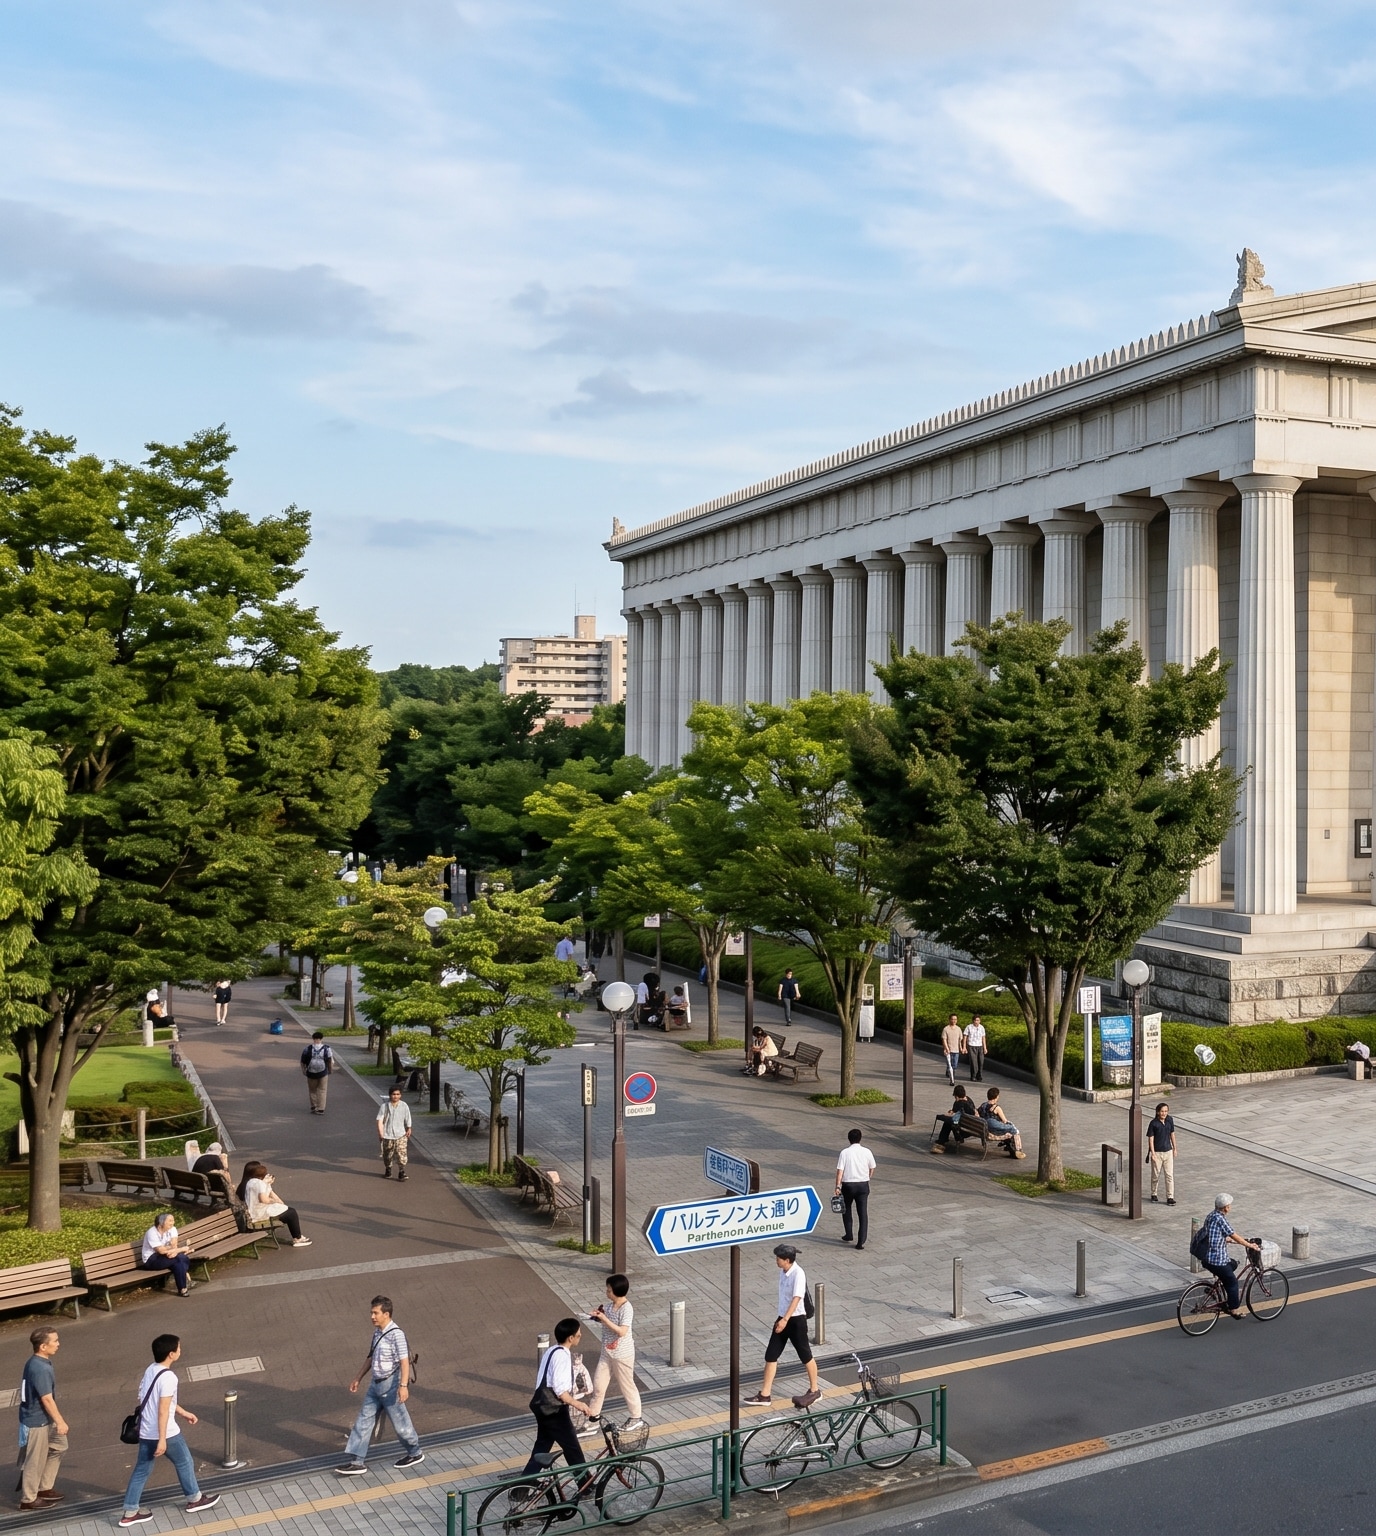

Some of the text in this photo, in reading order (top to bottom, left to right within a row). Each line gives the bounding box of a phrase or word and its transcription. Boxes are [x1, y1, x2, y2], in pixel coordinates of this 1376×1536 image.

[671, 1197, 799, 1233] パルテノン大通り
[687, 1222, 785, 1243] Parthenon Avenue
